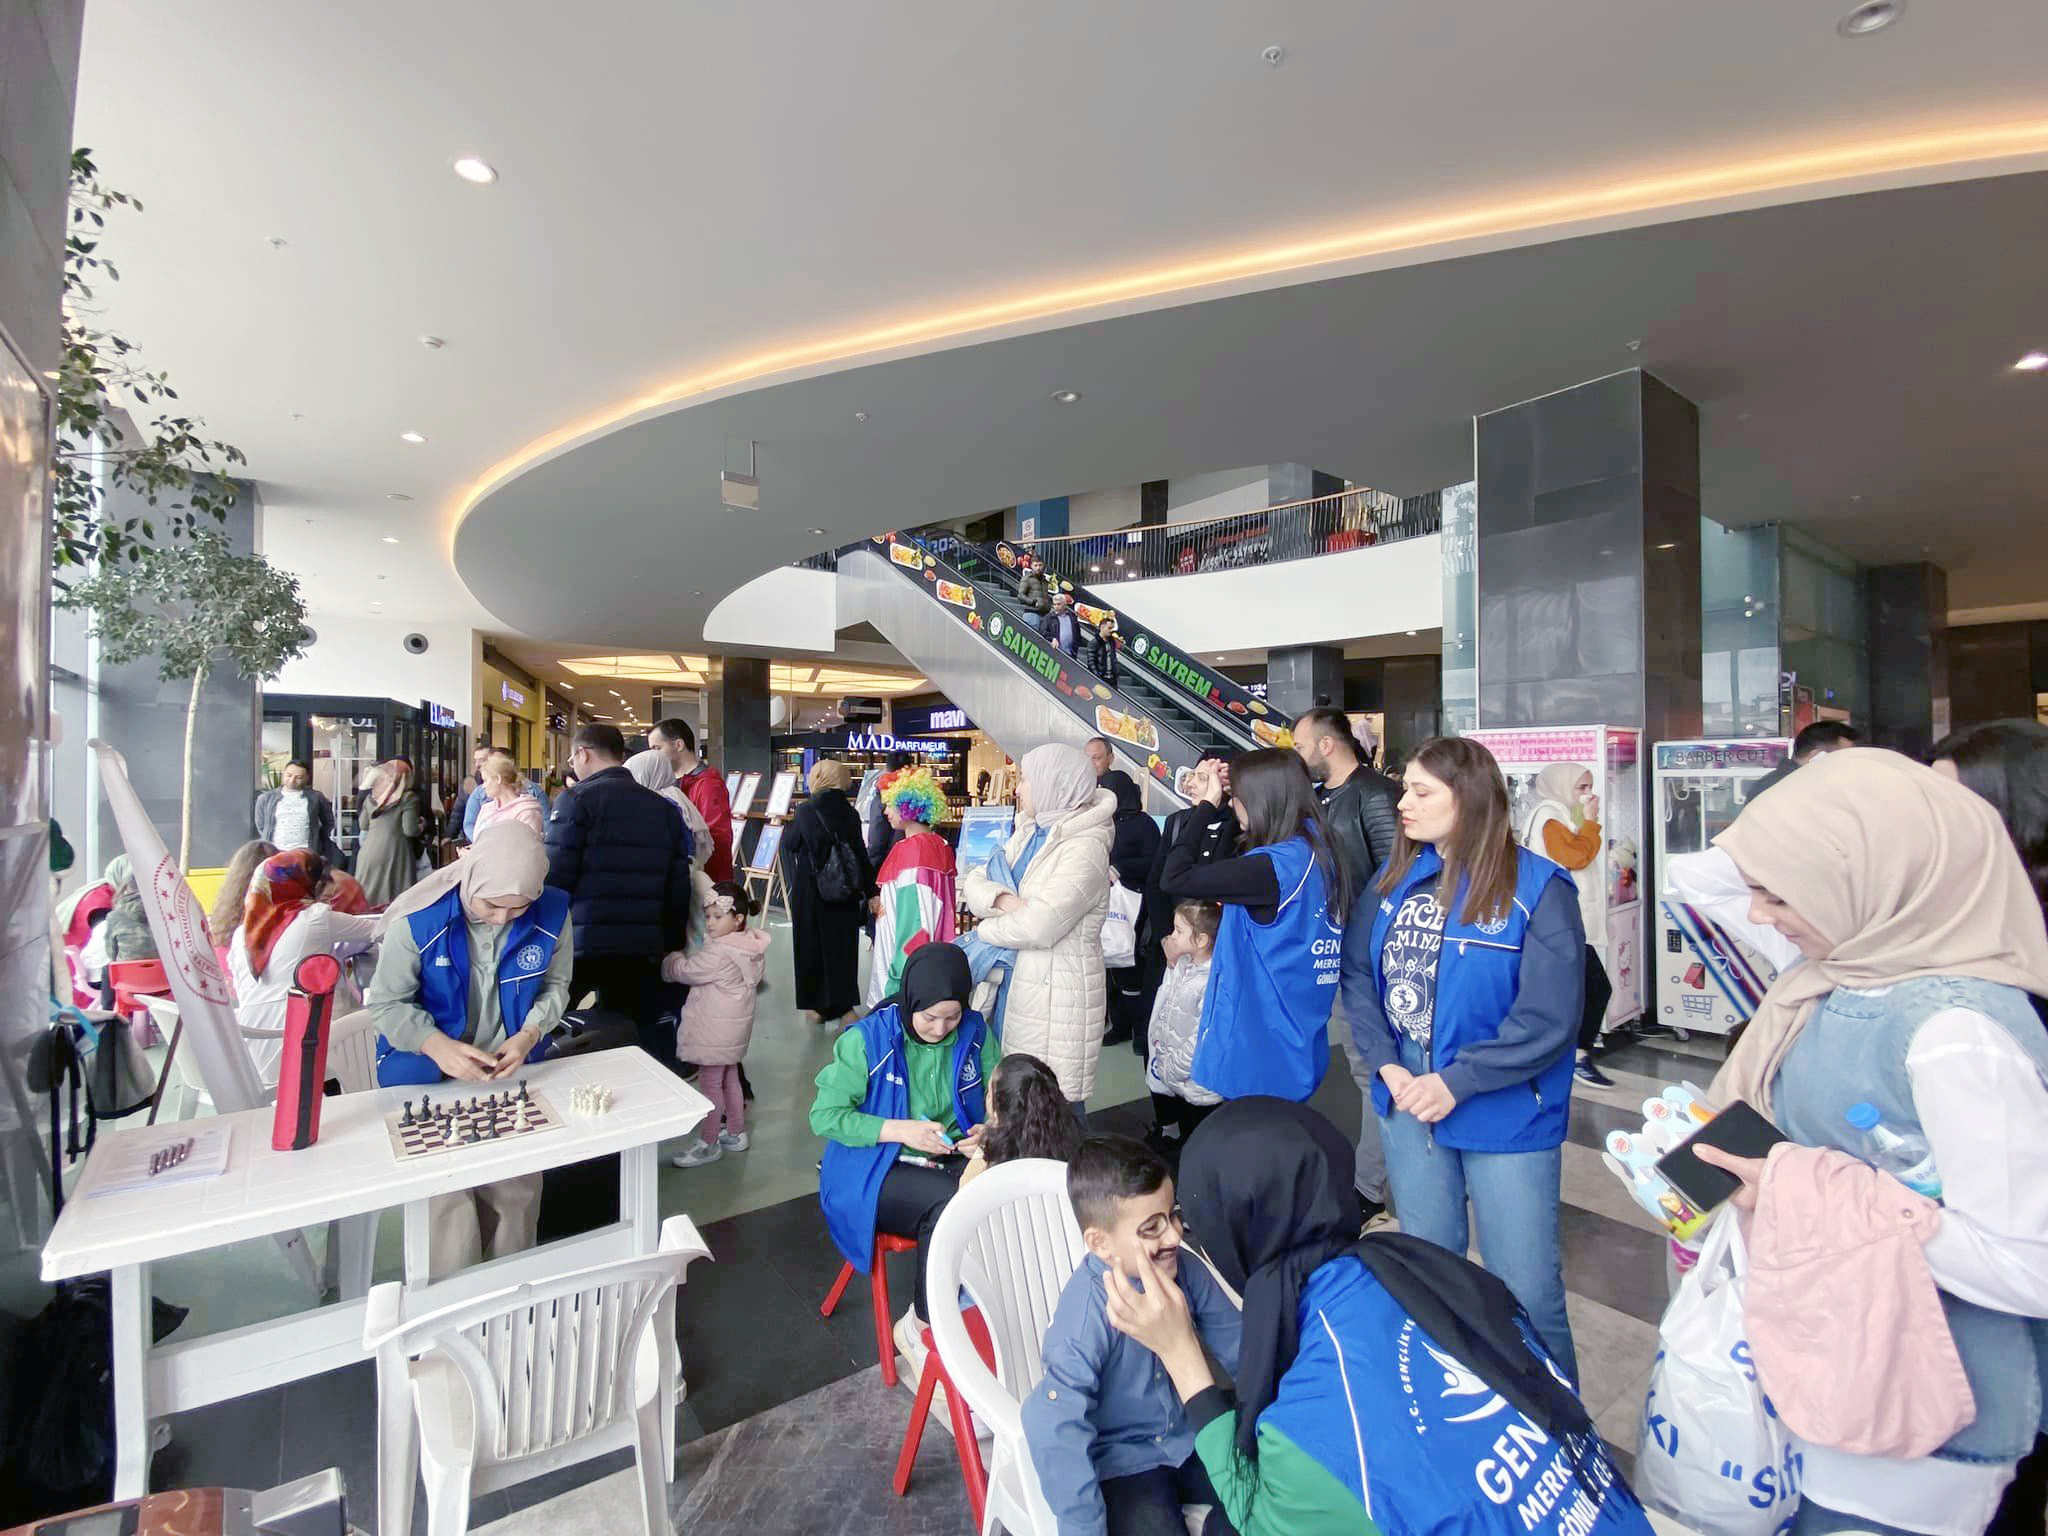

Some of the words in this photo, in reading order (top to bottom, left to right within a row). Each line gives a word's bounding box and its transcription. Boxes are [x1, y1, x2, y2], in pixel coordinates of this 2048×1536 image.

[1002, 624, 1061, 684] SAYREM
[1148, 645, 1213, 698] SAYREM
[895, 741, 947, 751] PARFUMEUR
[1676, 750, 1731, 762] BARBER
[1736, 749, 1766, 761] CUT
[1397, 1333, 1414, 1394] GENÇLİK
